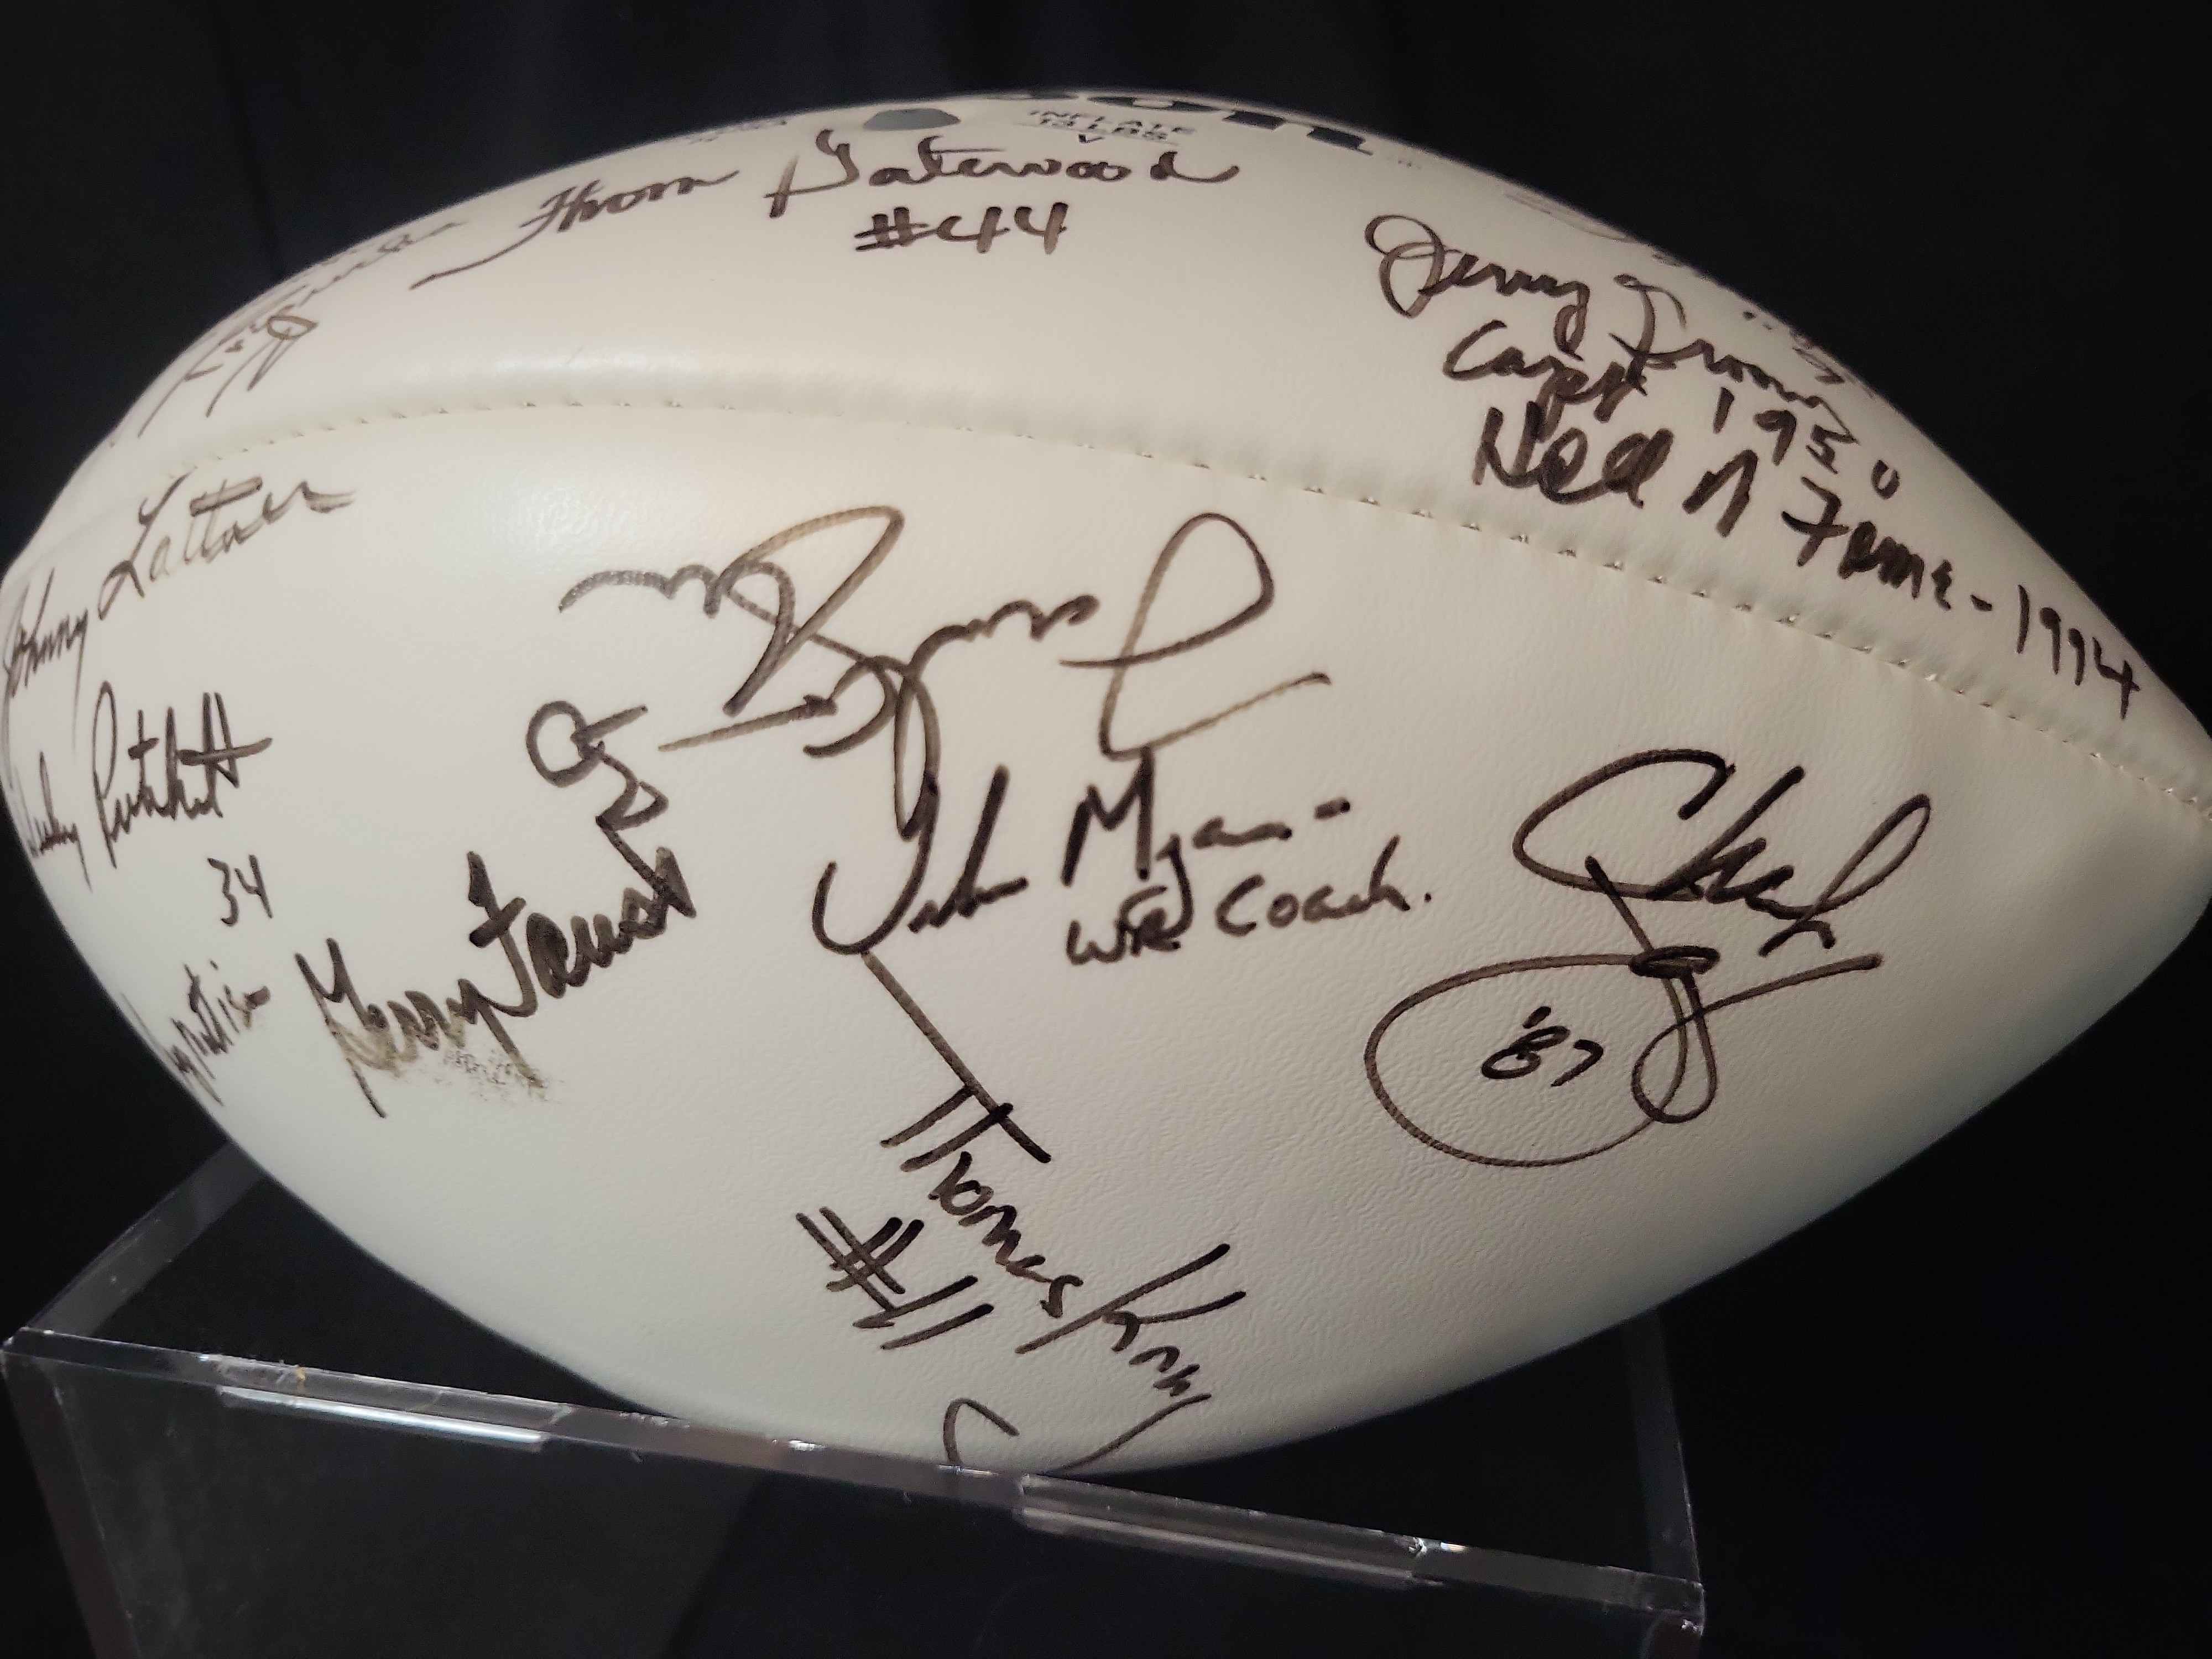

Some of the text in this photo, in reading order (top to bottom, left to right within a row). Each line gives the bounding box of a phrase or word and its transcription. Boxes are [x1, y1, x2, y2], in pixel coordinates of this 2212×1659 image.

[855, 202, 1068, 254] #44
[2017, 584, 2140, 721] 1994
[207, 854, 273, 926] 34
